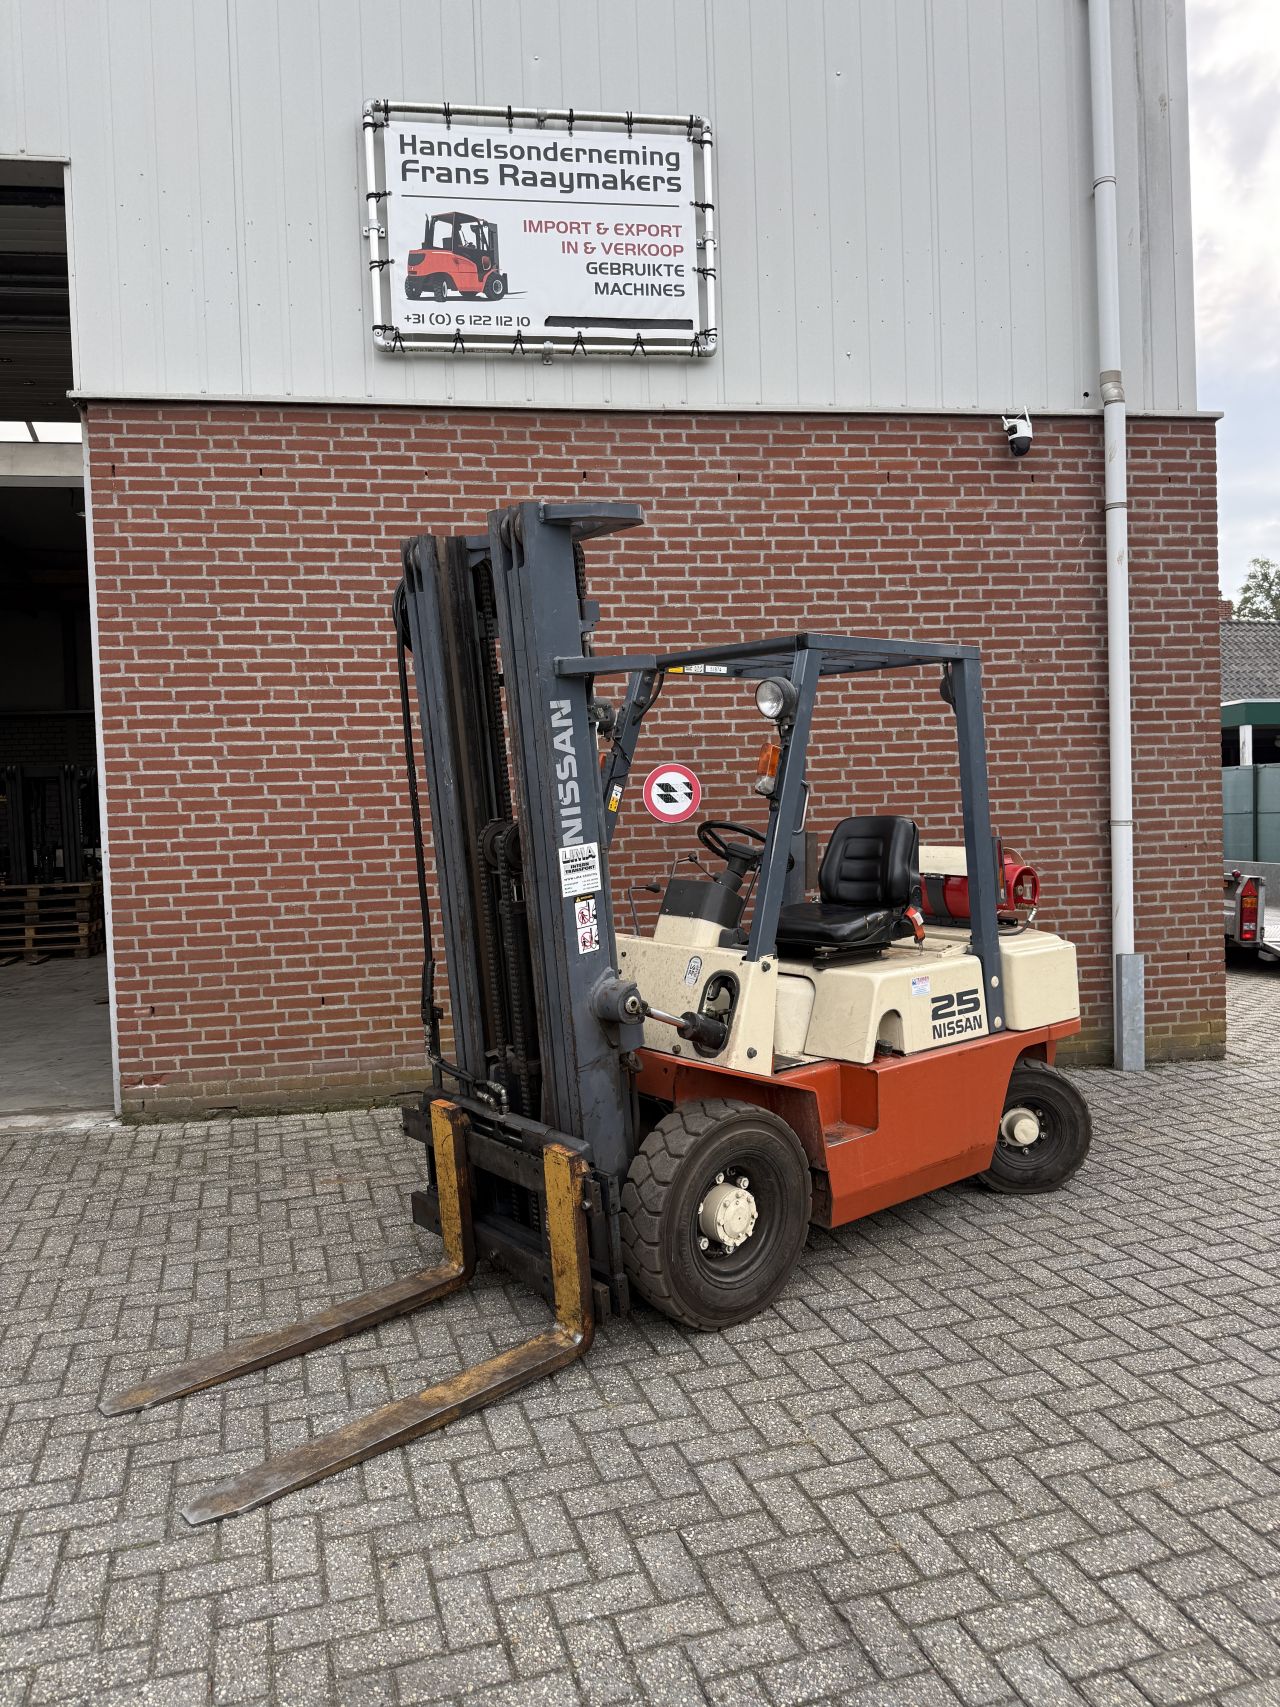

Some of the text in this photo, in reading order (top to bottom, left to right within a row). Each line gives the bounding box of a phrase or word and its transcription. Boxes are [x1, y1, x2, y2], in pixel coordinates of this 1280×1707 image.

[399, 134, 680, 171] Handelsonderneming
[401, 159, 682, 193] Frans Raaymakers
[523, 220, 682, 237] IMPORT & EXPORT
[561, 241, 684, 257] IN & VERKOOP
[586, 261, 685, 277] GEBRUIKTE
[594, 282, 686, 297] MACHINES
[404, 313, 531, 326] +31 (0) 6 122 112 10
[549, 699, 584, 847] NISSAN
[565, 865, 595, 874] TRANSPORT
[931, 988, 980, 1021] 25
[932, 1015, 983, 1040] NISSAN
